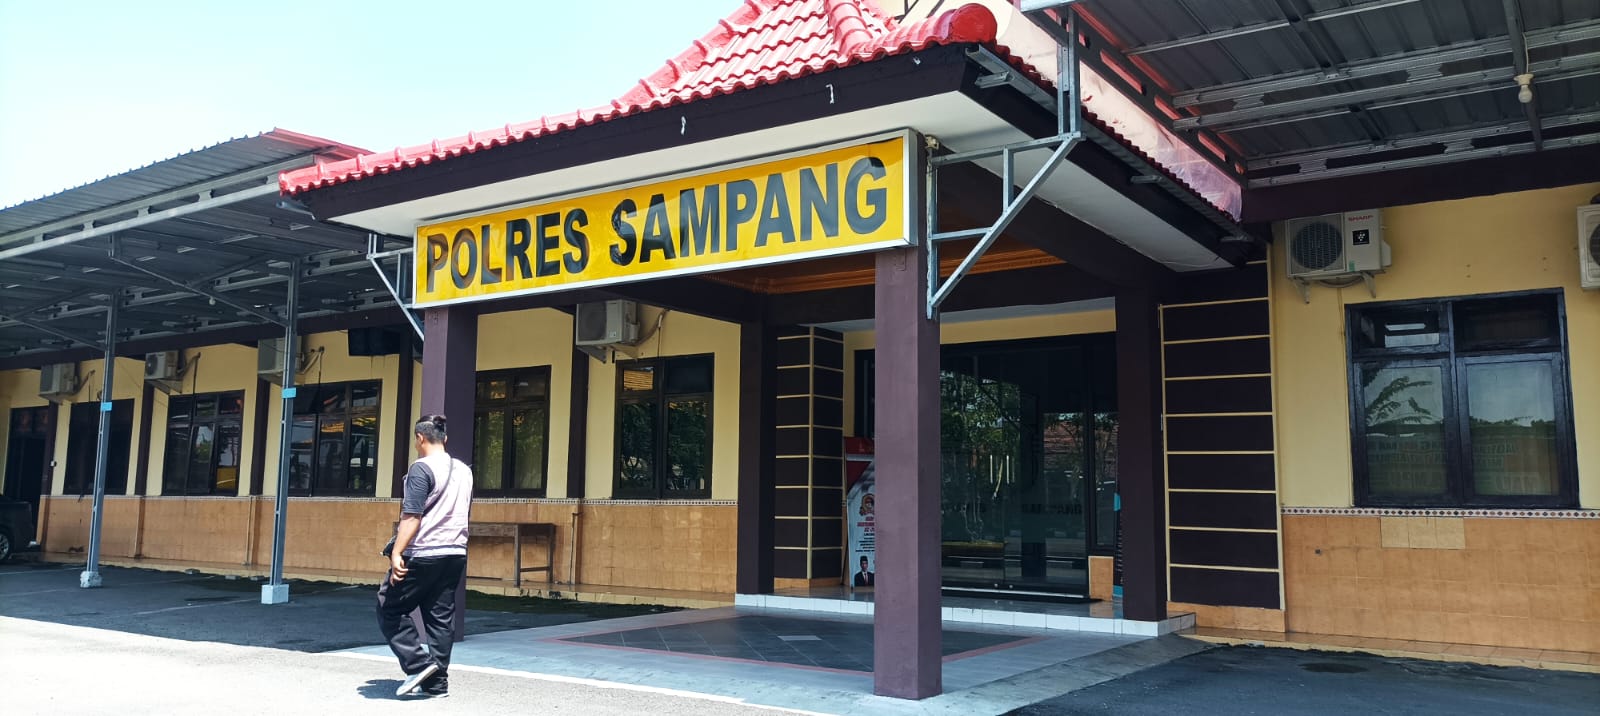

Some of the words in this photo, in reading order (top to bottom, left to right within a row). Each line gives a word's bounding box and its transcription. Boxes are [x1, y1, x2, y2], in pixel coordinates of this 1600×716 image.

[426, 208, 589, 293] POLRES
[610, 156, 888, 267] SAMPANG
[1348, 214, 1374, 222] SHARP
